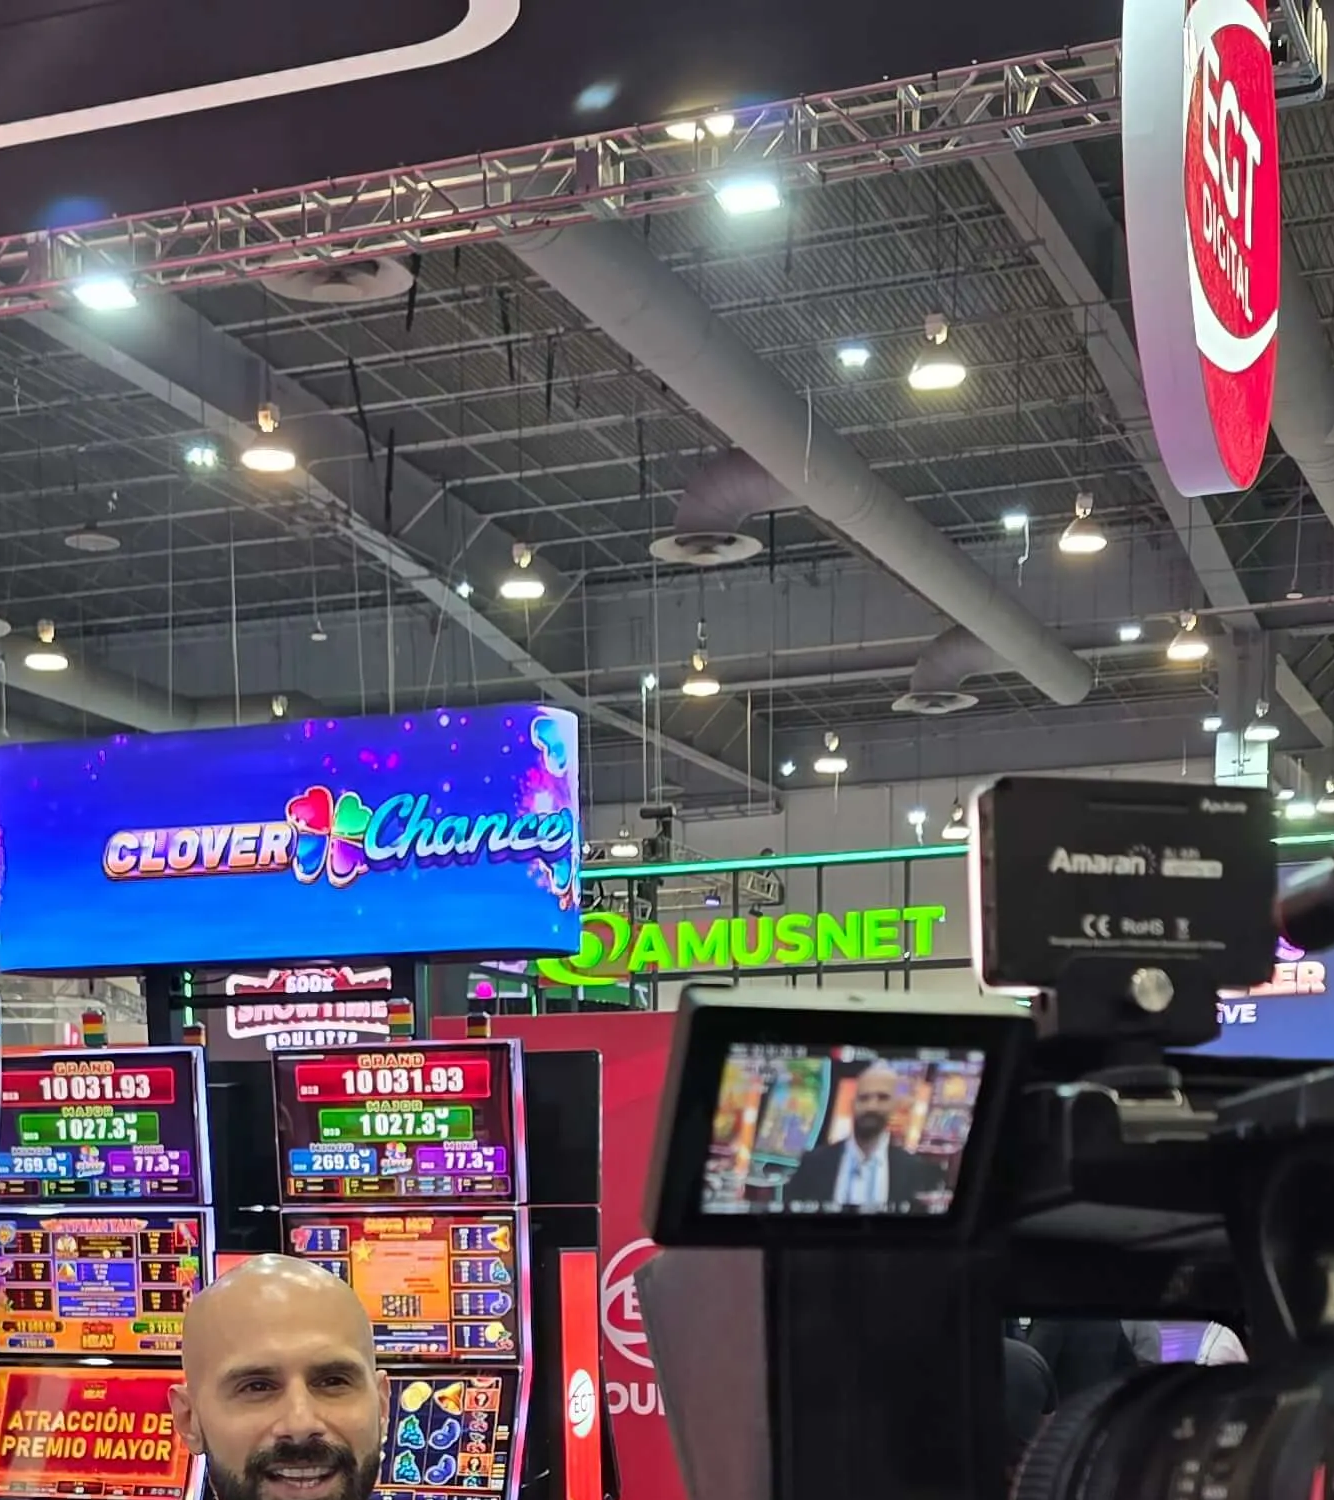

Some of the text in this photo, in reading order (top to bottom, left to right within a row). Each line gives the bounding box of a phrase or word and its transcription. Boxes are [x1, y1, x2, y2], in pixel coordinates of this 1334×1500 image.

[1202, 43, 1261, 250] EGT
[1202, 182, 1253, 322] DIGITAL
[106, 793, 576, 876] CLOVER Chance
[1048, 846, 1146, 875] Amaran
[629, 905, 946, 971] AMUSNET
[53, 1061, 115, 1076] GRAND
[358, 1053, 425, 1068] GRAND
[8, 1407, 173, 1435] ATRACCIÓN DE
[1, 1436, 172, 1462] PREMIO MAYOR
